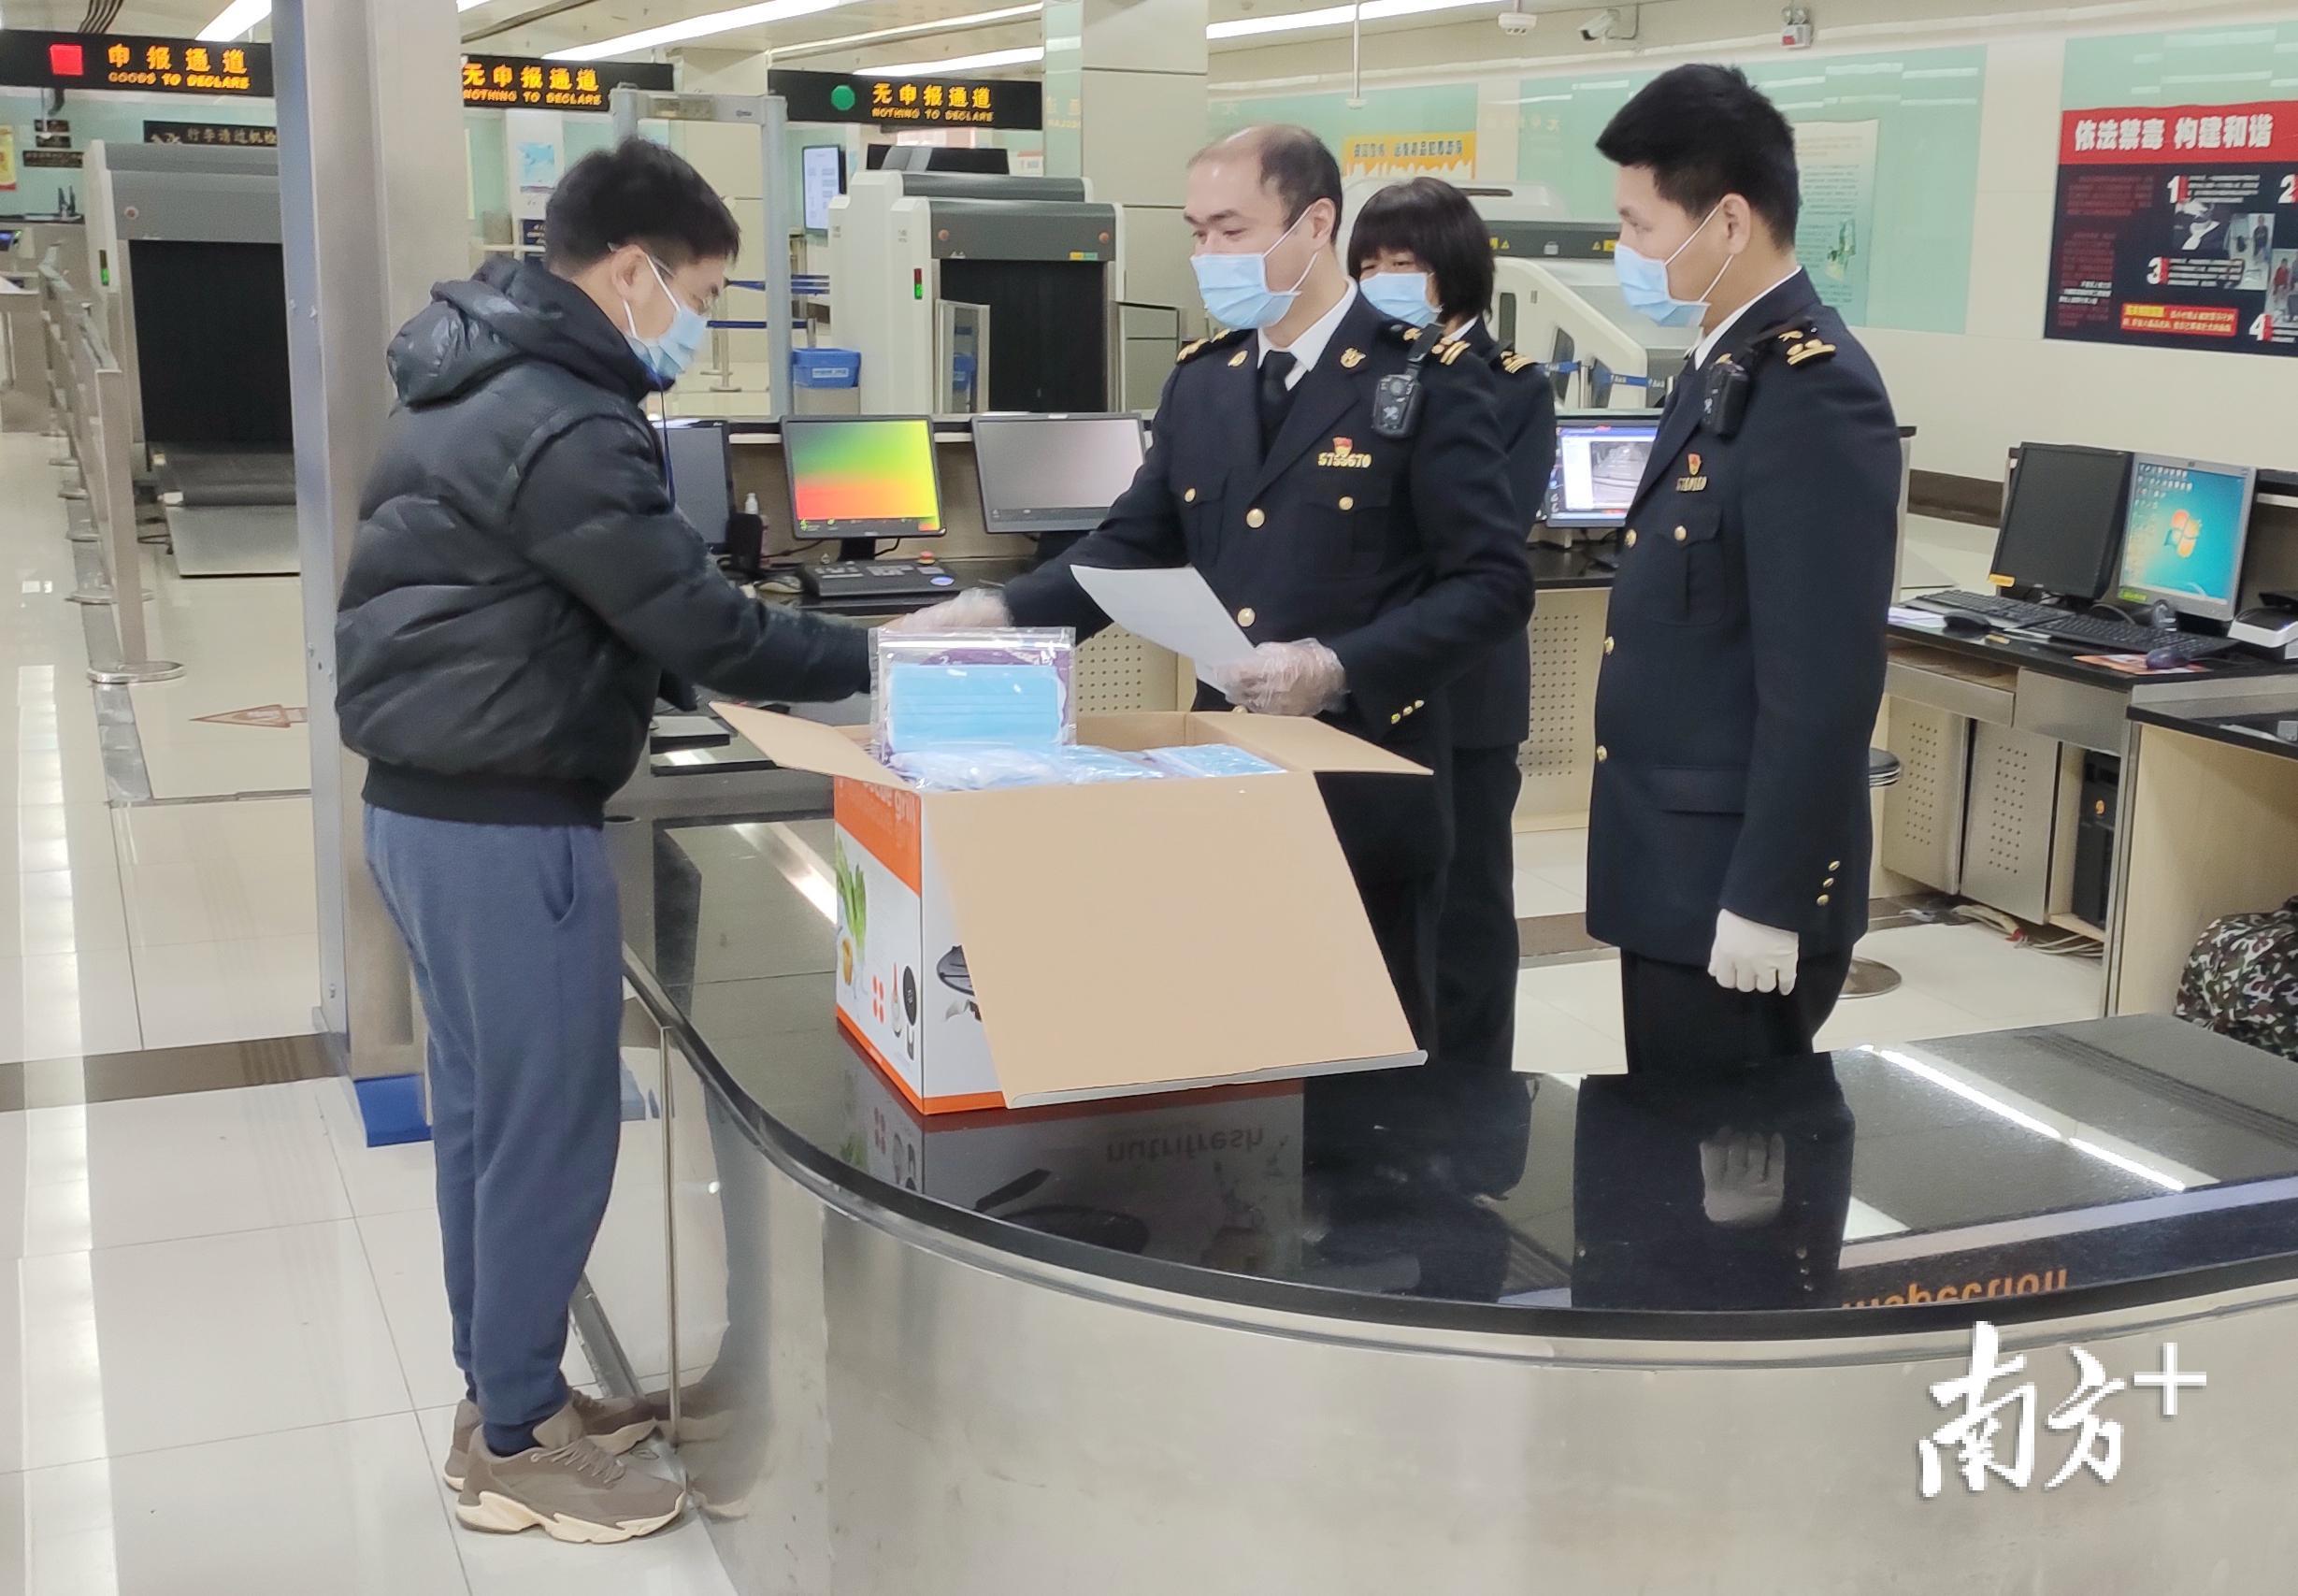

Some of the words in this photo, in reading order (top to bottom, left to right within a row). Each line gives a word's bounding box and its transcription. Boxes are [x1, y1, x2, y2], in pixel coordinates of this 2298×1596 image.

[108, 43, 248, 74] 申报通道
[108, 72, 156, 85] GOODS
[161, 73, 182, 86] TO
[187, 74, 250, 90] DECLARE
[463, 63, 599, 92] 无申报通道
[463, 89, 517, 102] NOTHING
[523, 91, 541, 103] TO
[545, 92, 602, 106] DECLARE
[872, 82, 992, 109] 无申报通道
[871, 107, 921, 120] NOTHING
[925, 108, 941, 121] TO
[944, 109, 995, 122] DECLARE
[2075, 118, 2166, 151] 依法禁毒
[2174, 112, 2275, 150] 构建和谐
